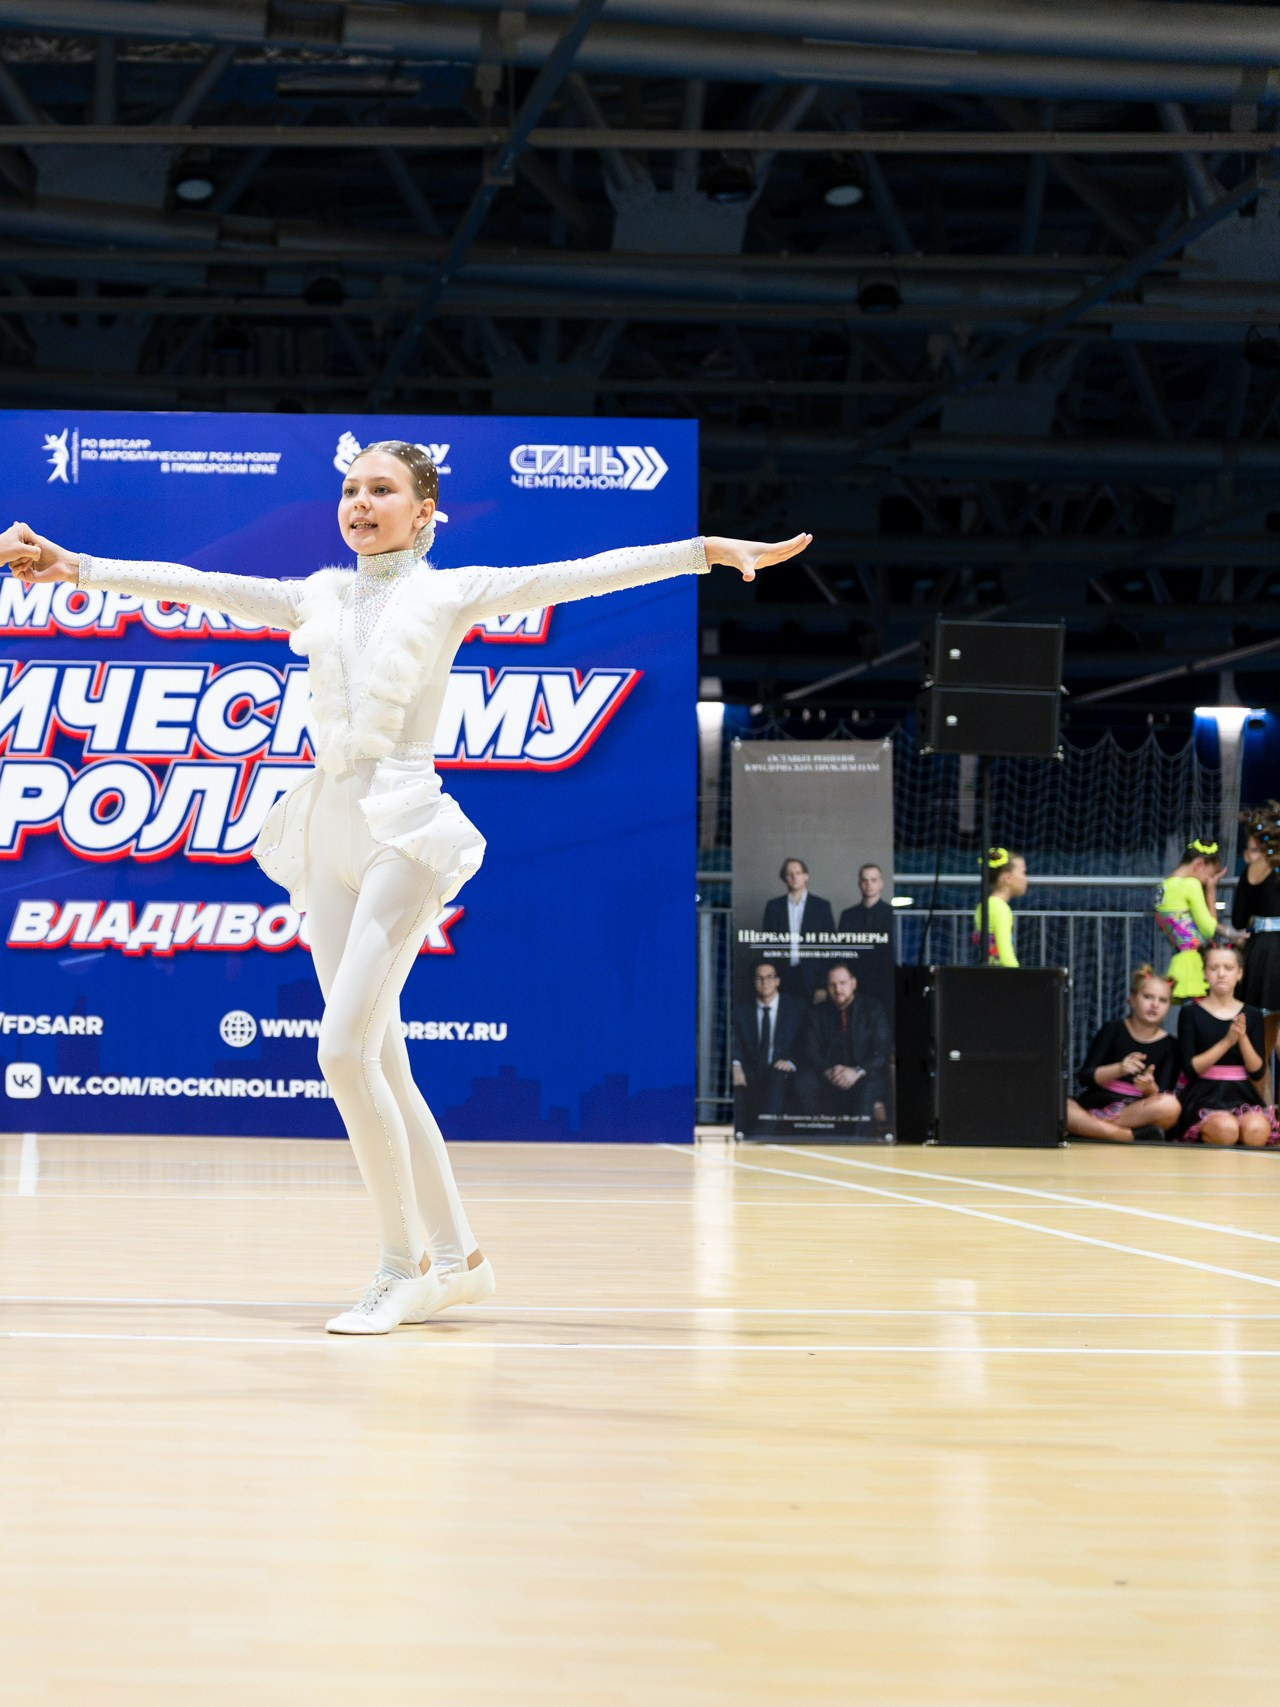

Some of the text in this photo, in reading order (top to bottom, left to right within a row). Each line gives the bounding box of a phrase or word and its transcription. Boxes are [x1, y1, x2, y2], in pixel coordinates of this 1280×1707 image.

[81, 439, 98, 449] РО
[81, 449, 281, 463] ПО АКРОБАТИЧЕСКОМУ РОК-Н-РОЛЛУ
[509, 444, 624, 475] СТАНЬ
[171, 462, 248, 474] ПРИМОРСКОМ
[249, 463, 277, 474] КРАЕ
[511, 474, 625, 489] ЧЕМПИОНОМ
[47, 1075, 333, 1099] VK.COM/ROCKNROLLPRI
